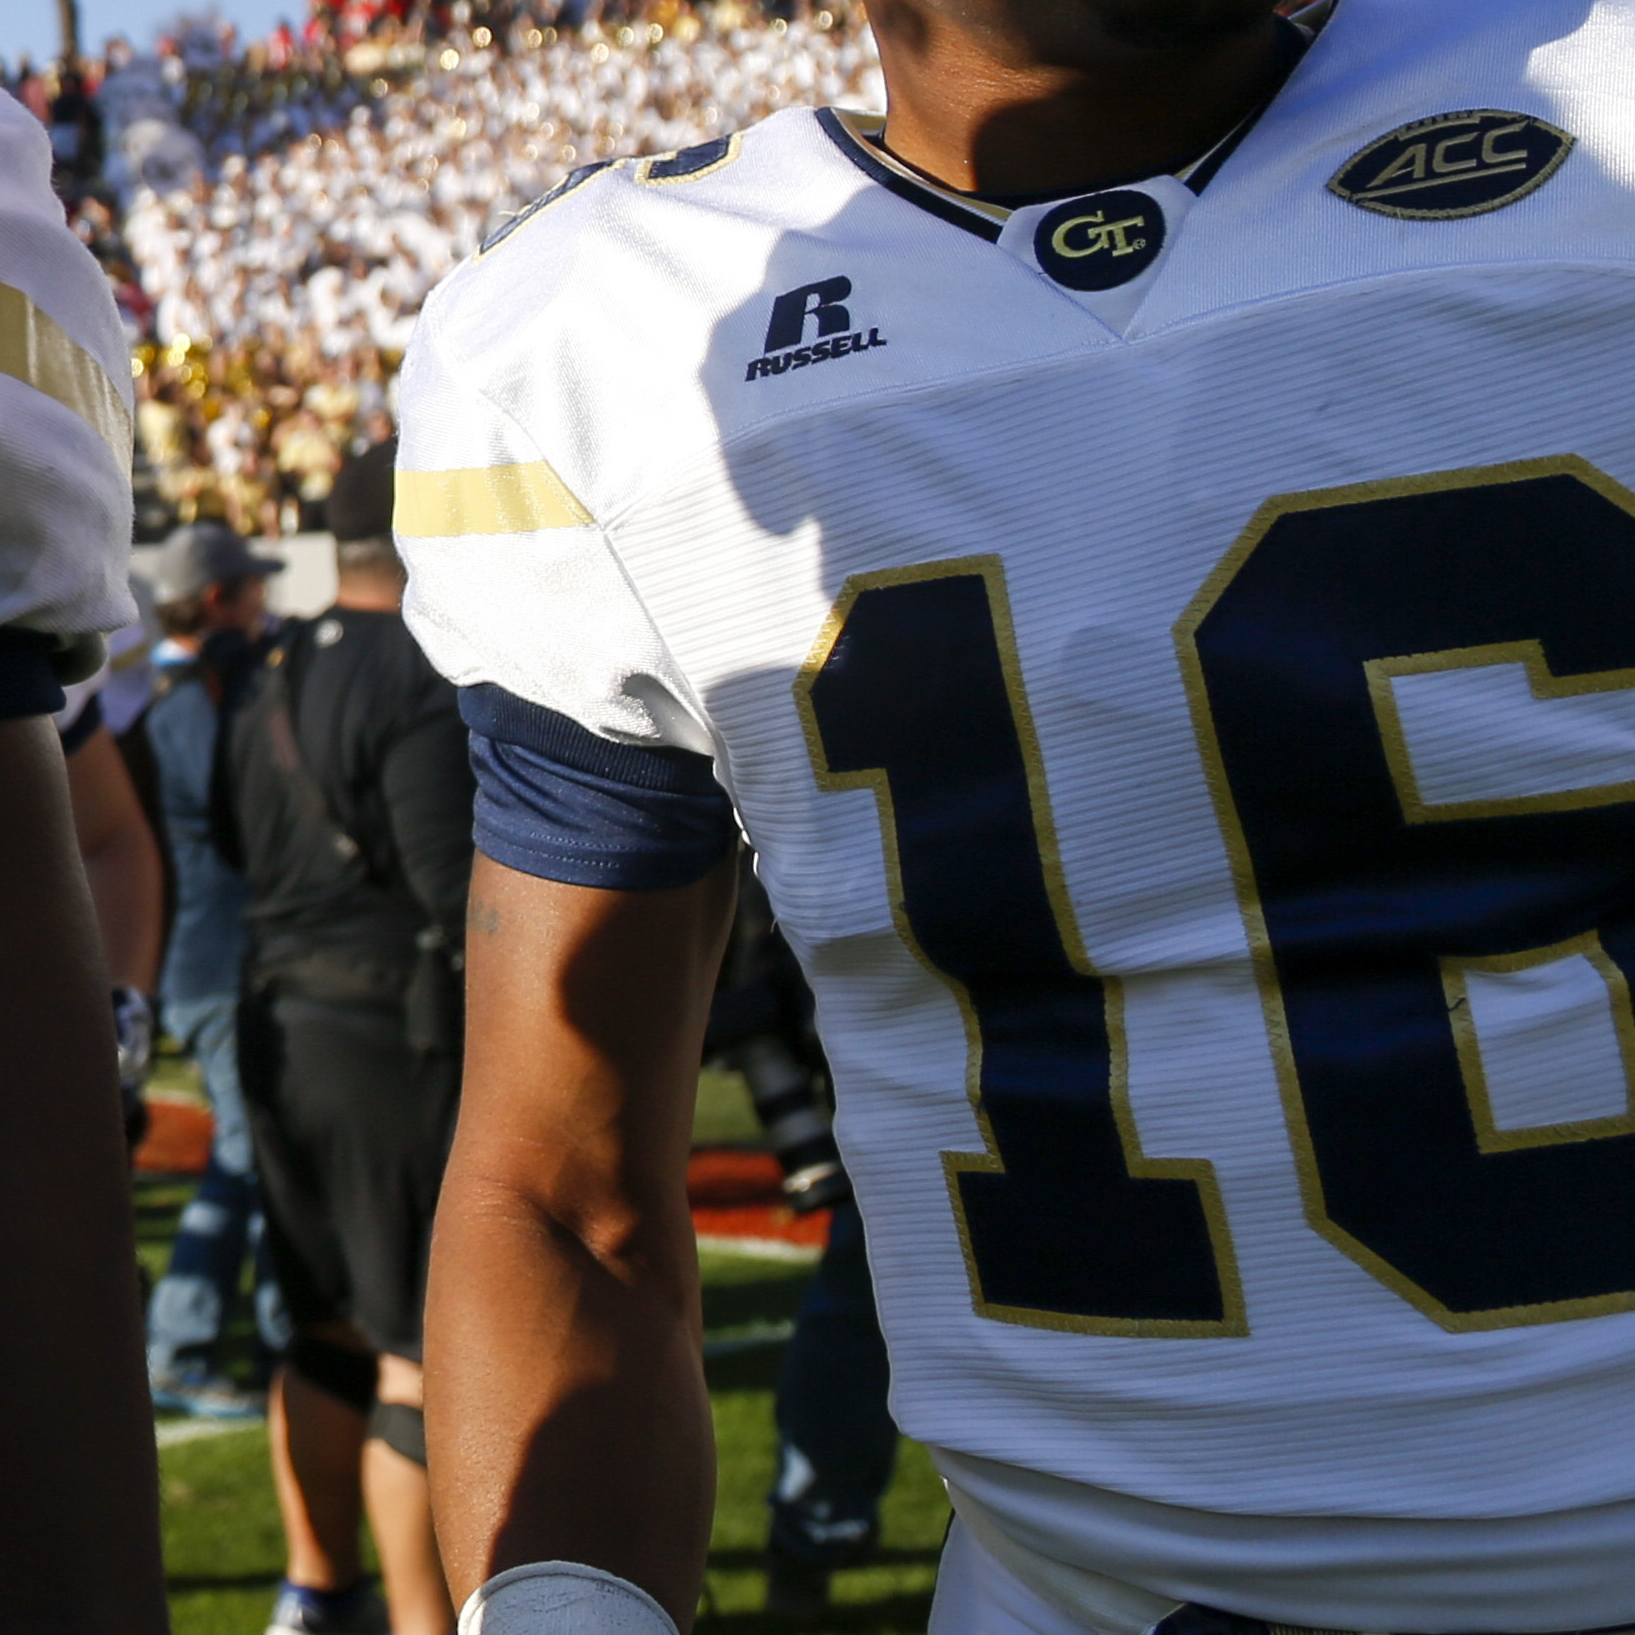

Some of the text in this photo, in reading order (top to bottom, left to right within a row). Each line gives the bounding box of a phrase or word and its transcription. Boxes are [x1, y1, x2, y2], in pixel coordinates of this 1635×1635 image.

[1366, 120, 1530, 188] ACC
[745, 327, 888, 382] RUSSELL
[793, 453, 1635, 1338] 16
